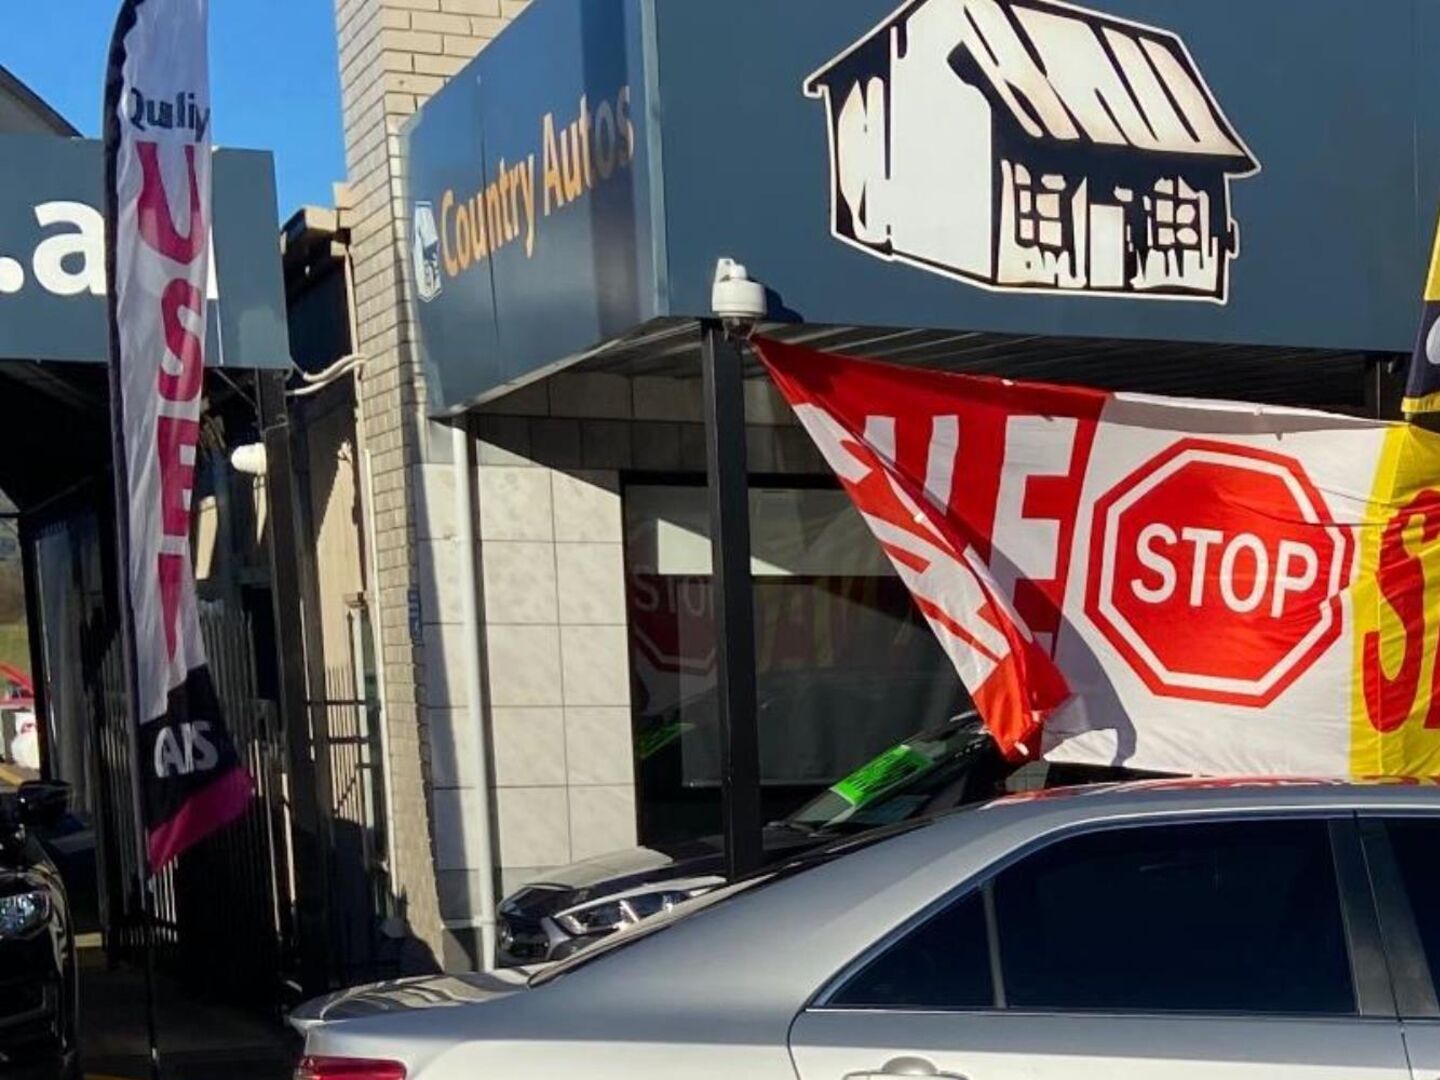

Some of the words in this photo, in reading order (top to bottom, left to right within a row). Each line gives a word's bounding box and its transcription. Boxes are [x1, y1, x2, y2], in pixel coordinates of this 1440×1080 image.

[440, 153, 535, 278] Country
[542, 84, 635, 218] Autos
[1130, 522, 1319, 619] STOP
